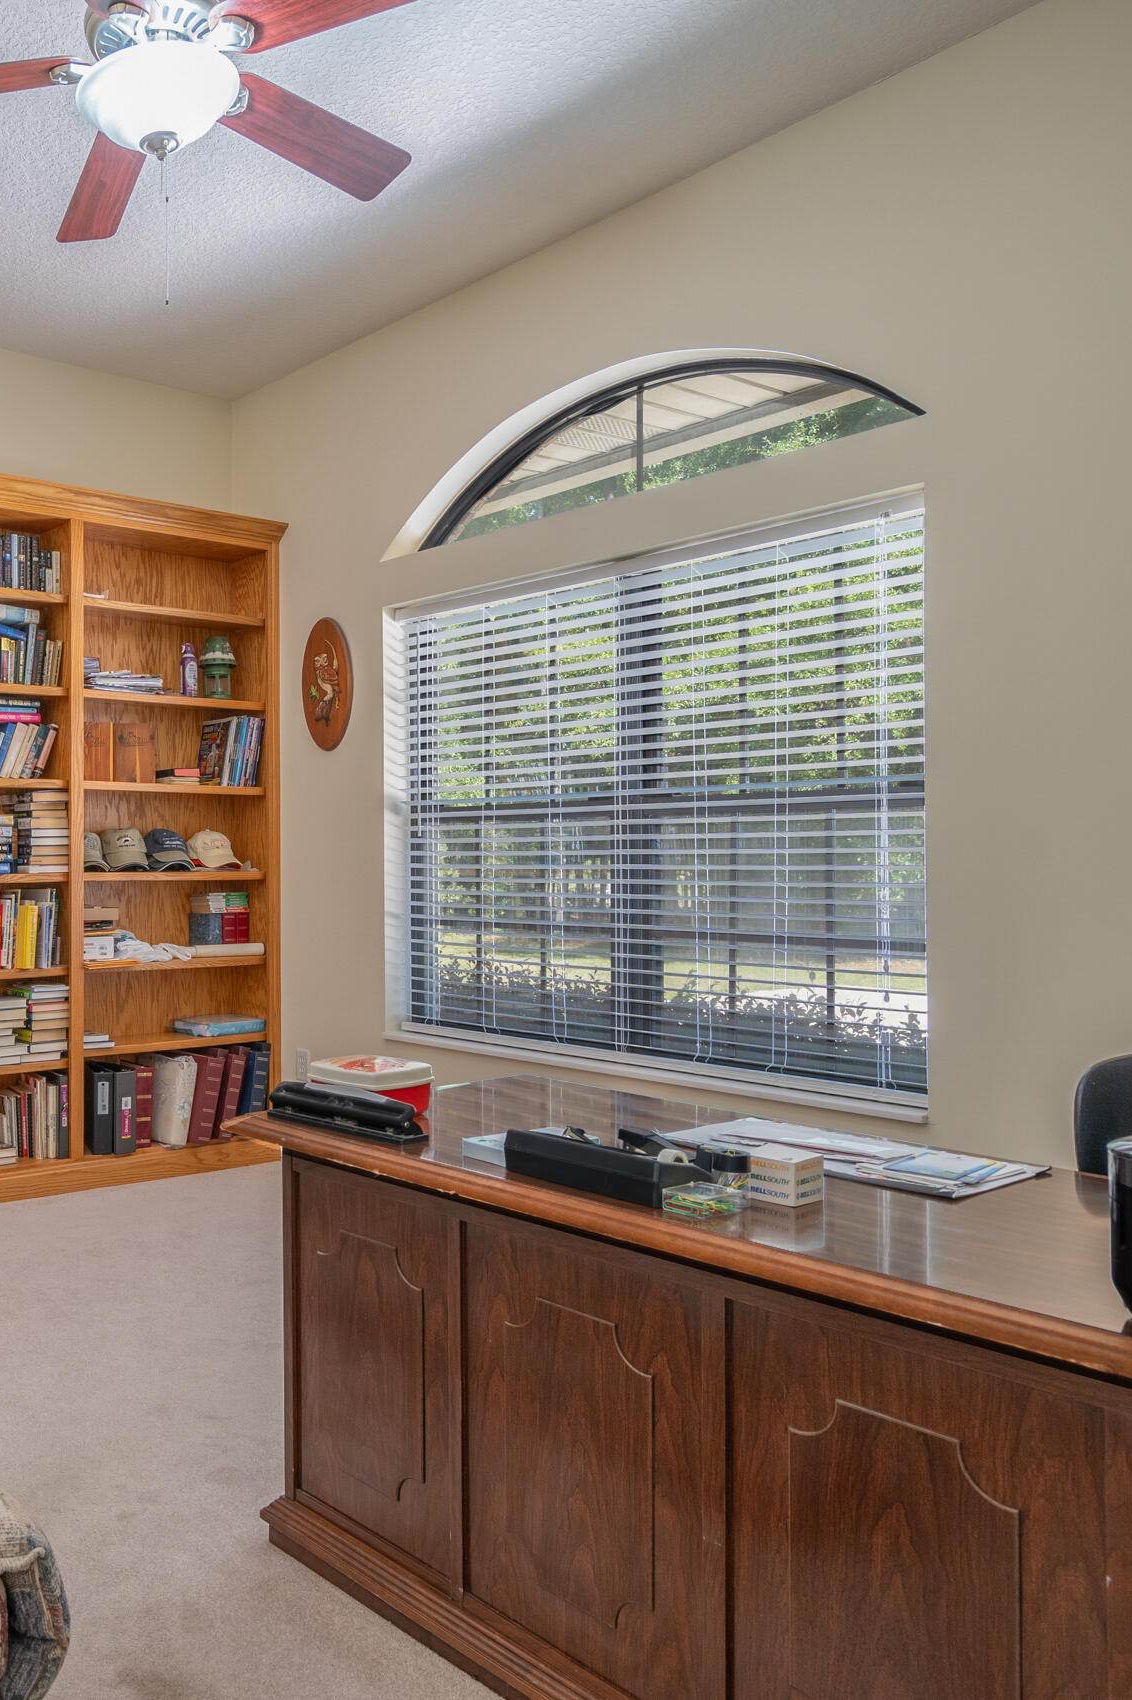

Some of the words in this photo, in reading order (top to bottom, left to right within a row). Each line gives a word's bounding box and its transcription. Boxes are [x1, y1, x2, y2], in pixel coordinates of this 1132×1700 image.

[750, 1159, 789, 1172] BELLSOUTH
[750, 1173, 790, 1185] BELLSOUTH
[750, 1186, 789, 1199] BELLSOUTH
